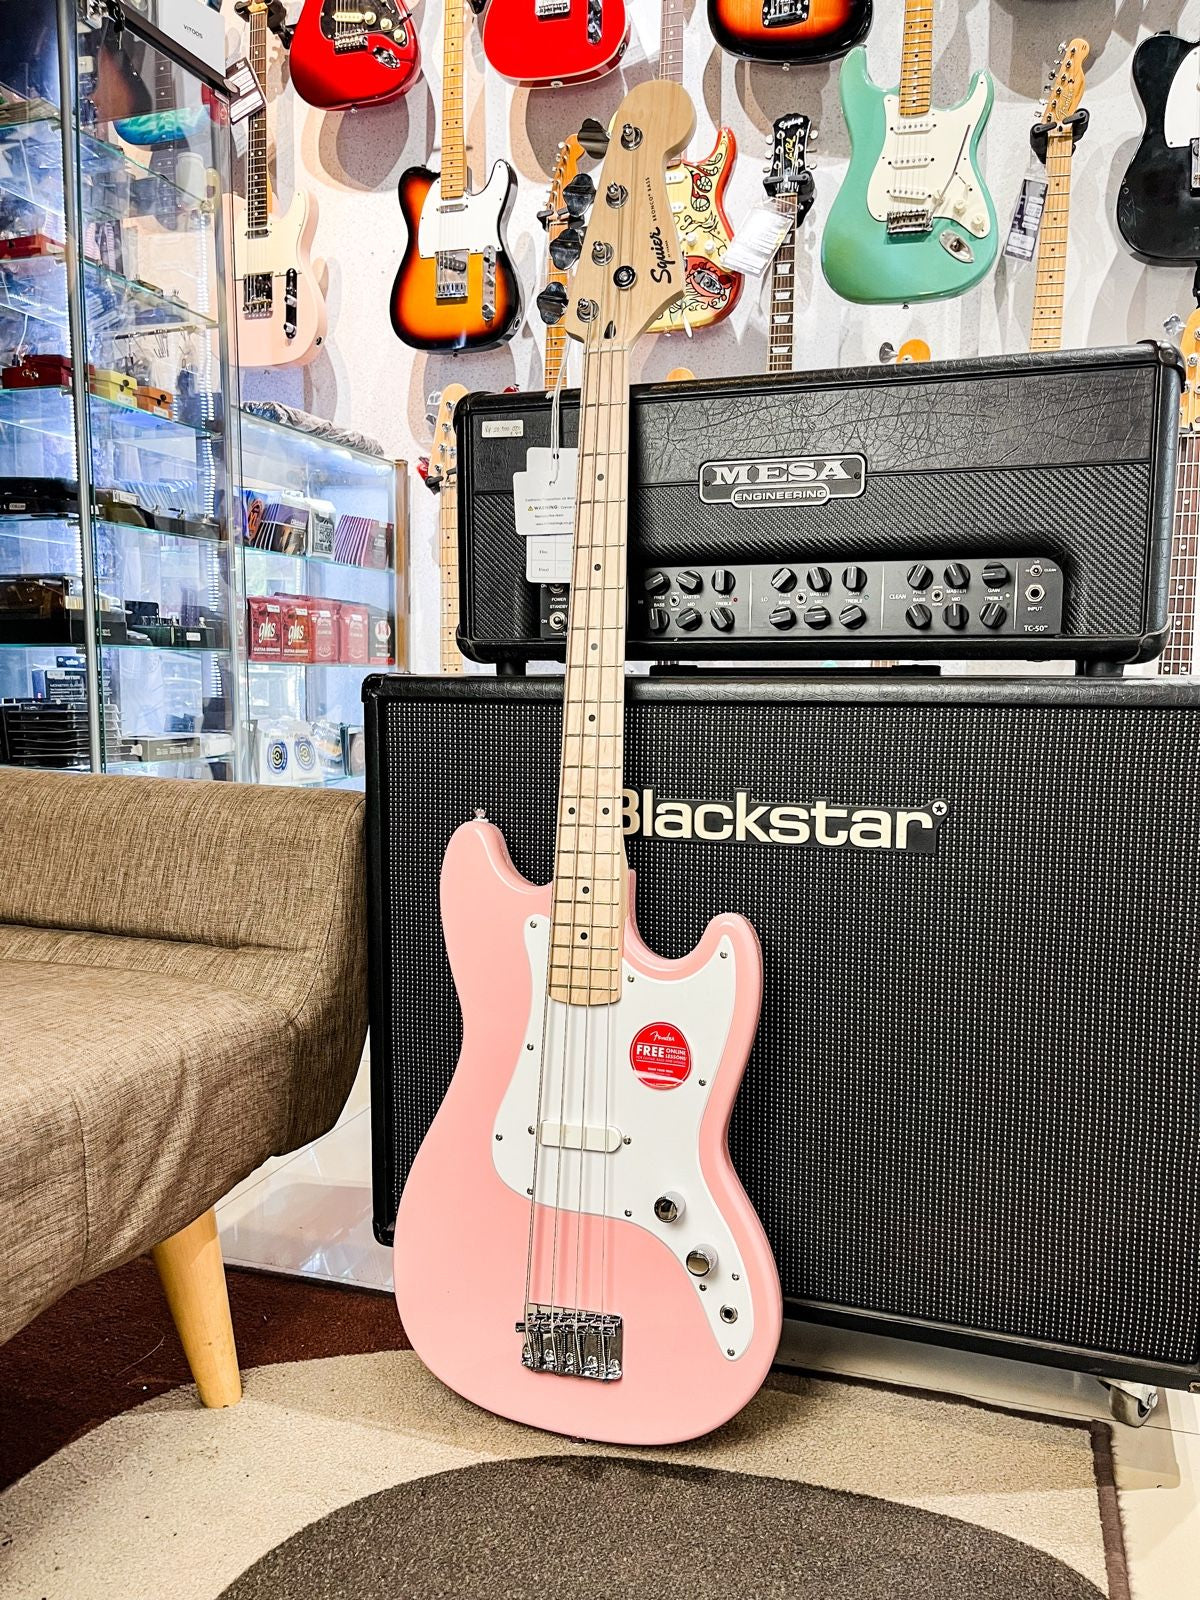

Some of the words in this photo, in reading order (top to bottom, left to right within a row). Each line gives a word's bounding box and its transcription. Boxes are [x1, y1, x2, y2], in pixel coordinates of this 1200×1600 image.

[183, 24, 203, 39] VITOOS
[650, 226, 676, 284] Squier
[711, 460, 852, 486] MESA
[734, 489, 827, 501] ENGINEERING
[258, 616, 276, 644] ghs
[288, 619, 305, 646] ghs
[622, 788, 934, 850] Blackstar
[650, 1030, 675, 1042] Fender
[636, 1044, 665, 1058] FREE
[665, 1047, 686, 1056] ONLINE
